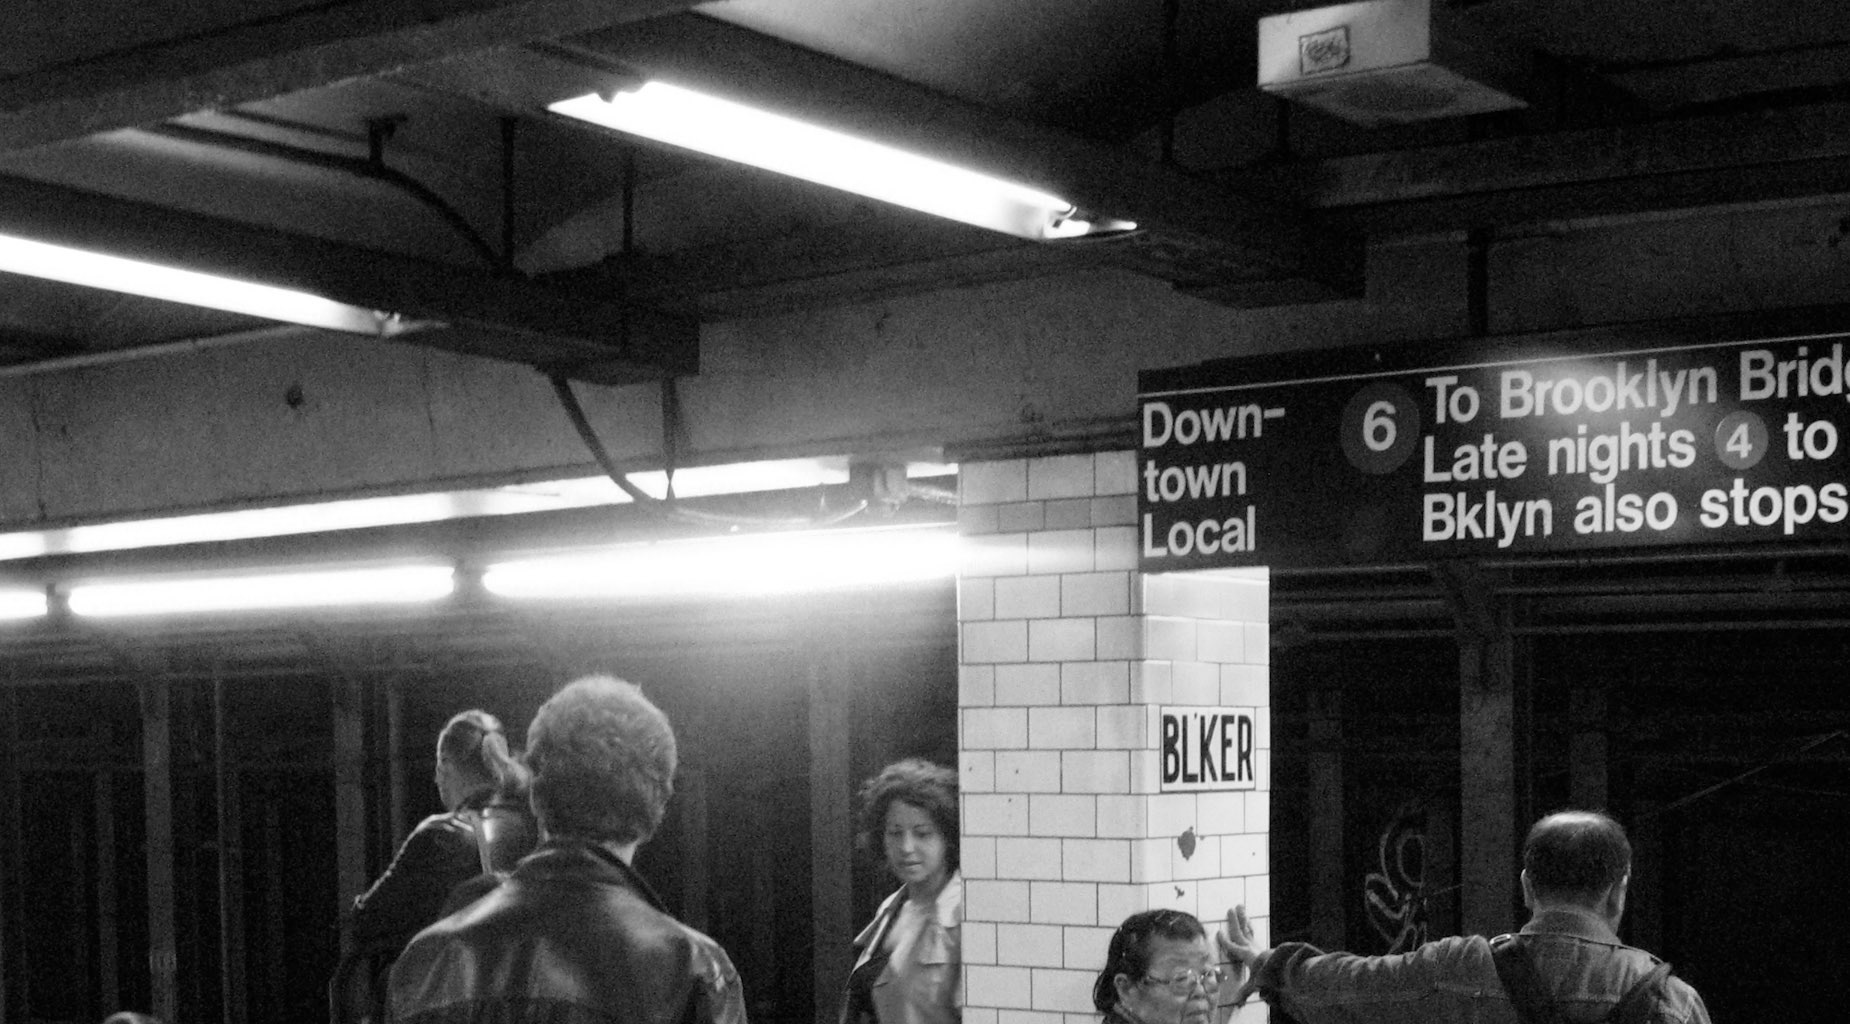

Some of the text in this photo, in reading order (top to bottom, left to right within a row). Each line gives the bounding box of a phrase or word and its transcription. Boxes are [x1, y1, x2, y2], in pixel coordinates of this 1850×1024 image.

[1426, 343, 1850, 424] To Brooklyn Brid
[1143, 402, 1286, 448] Down-
[1363, 401, 1397, 452] 6
[1424, 412, 1838, 485] Late nights 4 to
[1144, 459, 1247, 503] town
[1143, 505, 1256, 558] Local
[1423, 478, 1849, 548] Bklyn also stops
